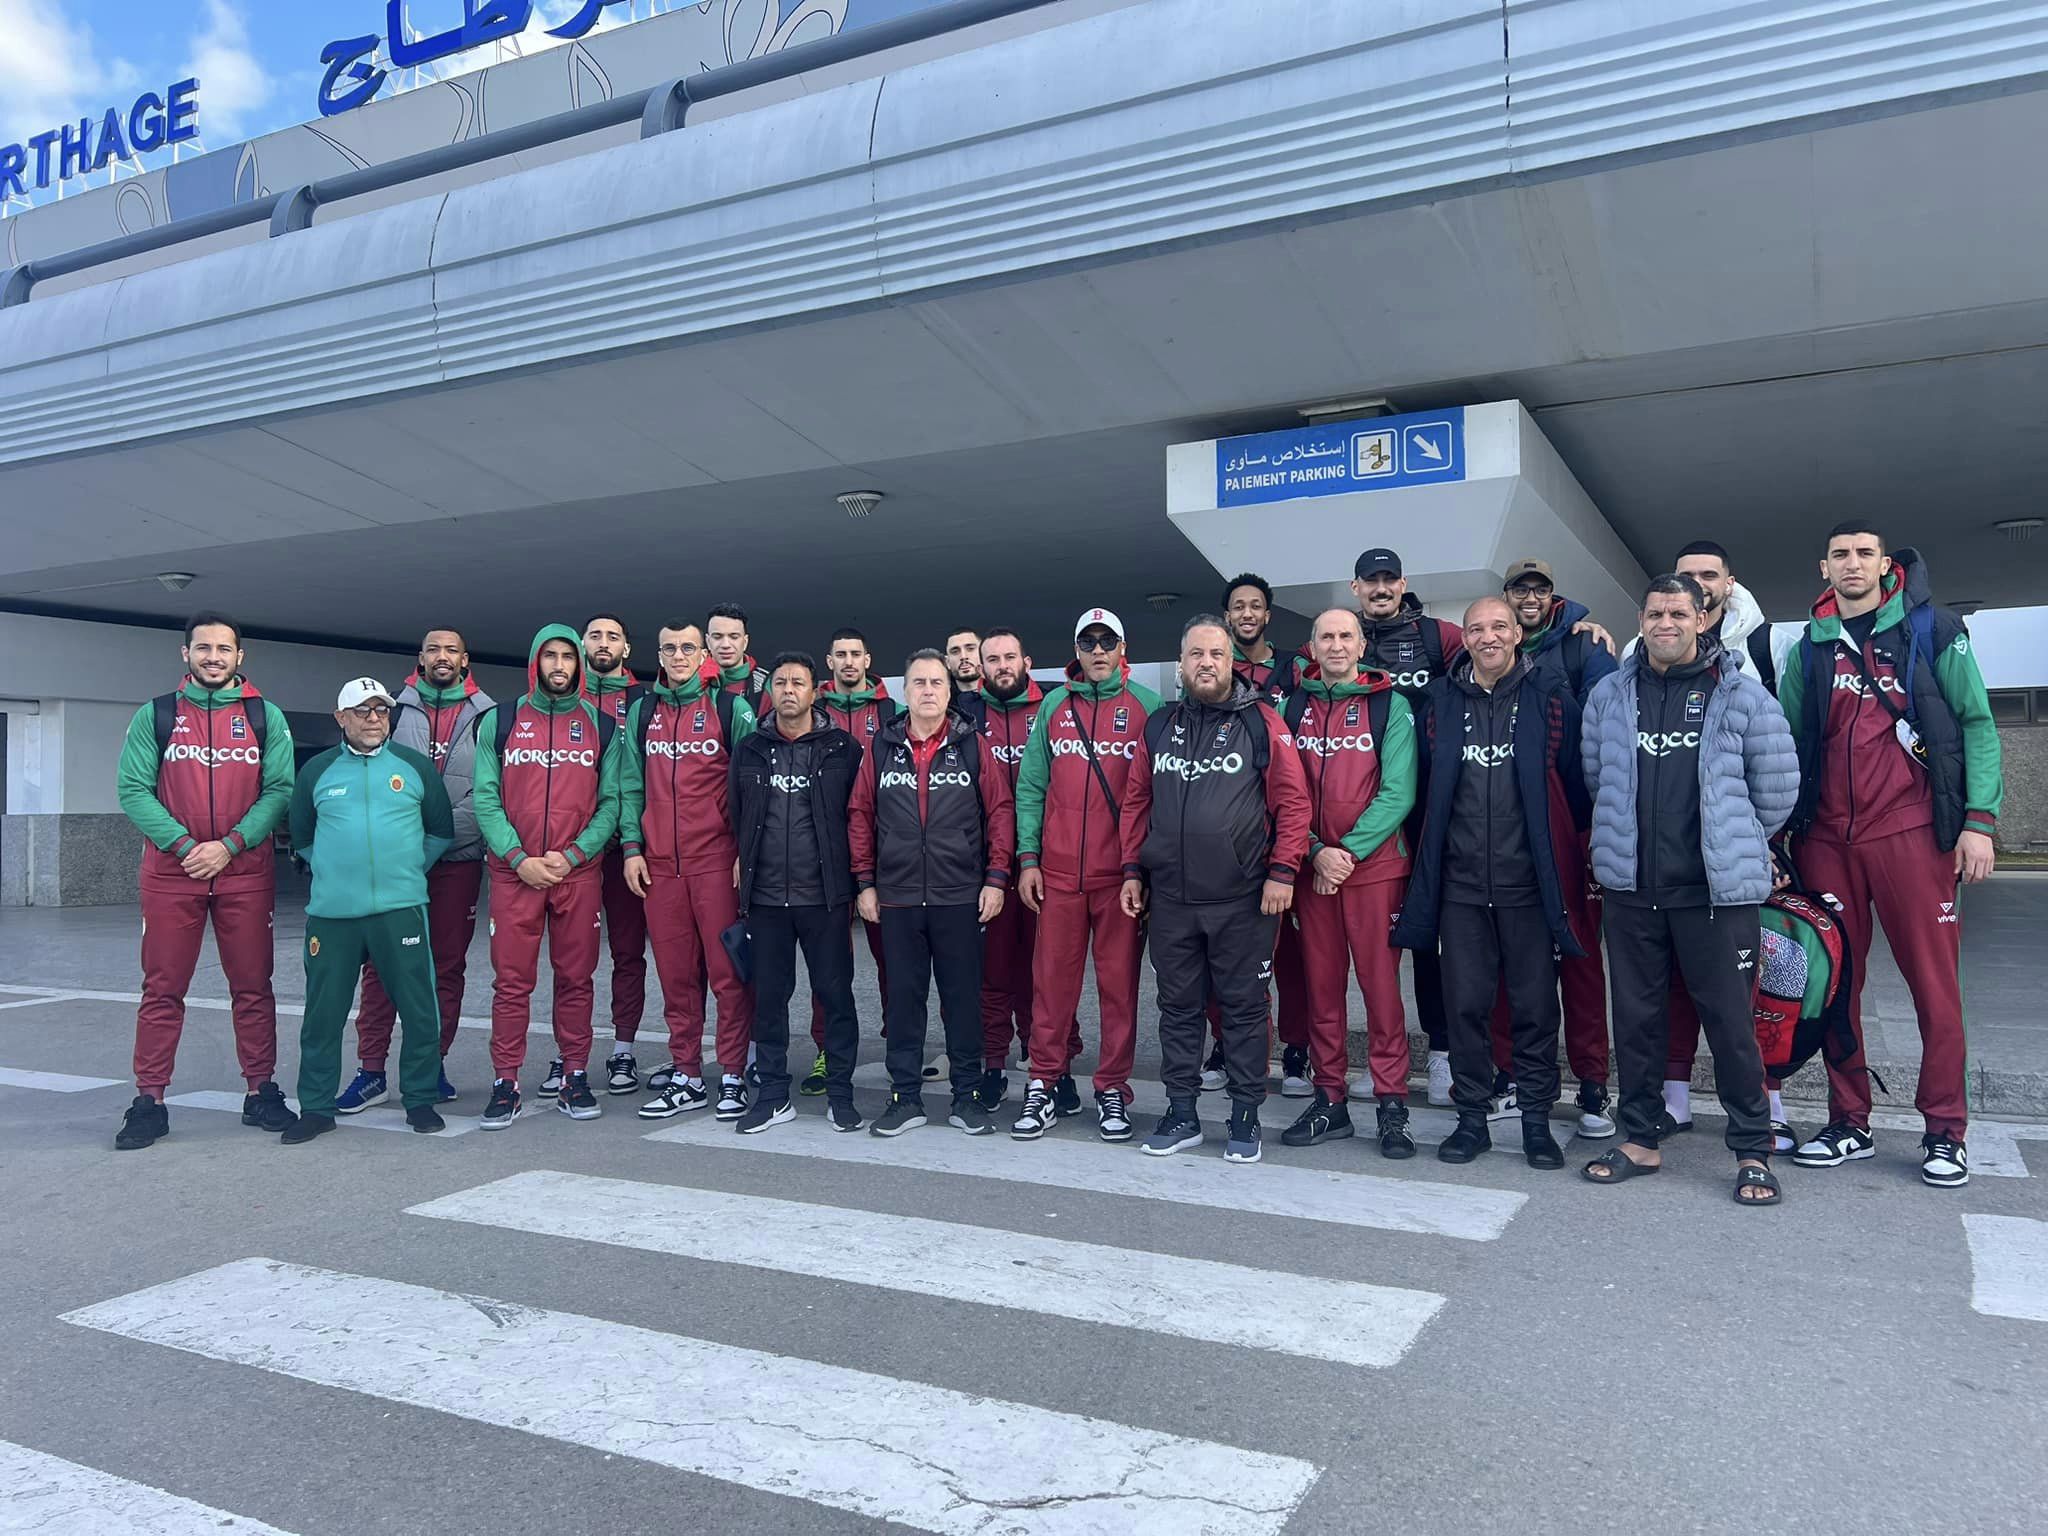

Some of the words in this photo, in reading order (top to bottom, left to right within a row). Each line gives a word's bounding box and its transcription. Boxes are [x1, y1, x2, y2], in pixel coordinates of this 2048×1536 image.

[1225, 471, 1287, 491] PAIEMENT
[1290, 464, 1346, 483] PARKING
[360, 680, 377, 691] H
[163, 742, 260, 768] MOROCCO
[1295, 732, 1375, 757] OROCCO
[503, 747, 595, 769] MOROCCO
[1152, 752, 1243, 781] MOROCCO
